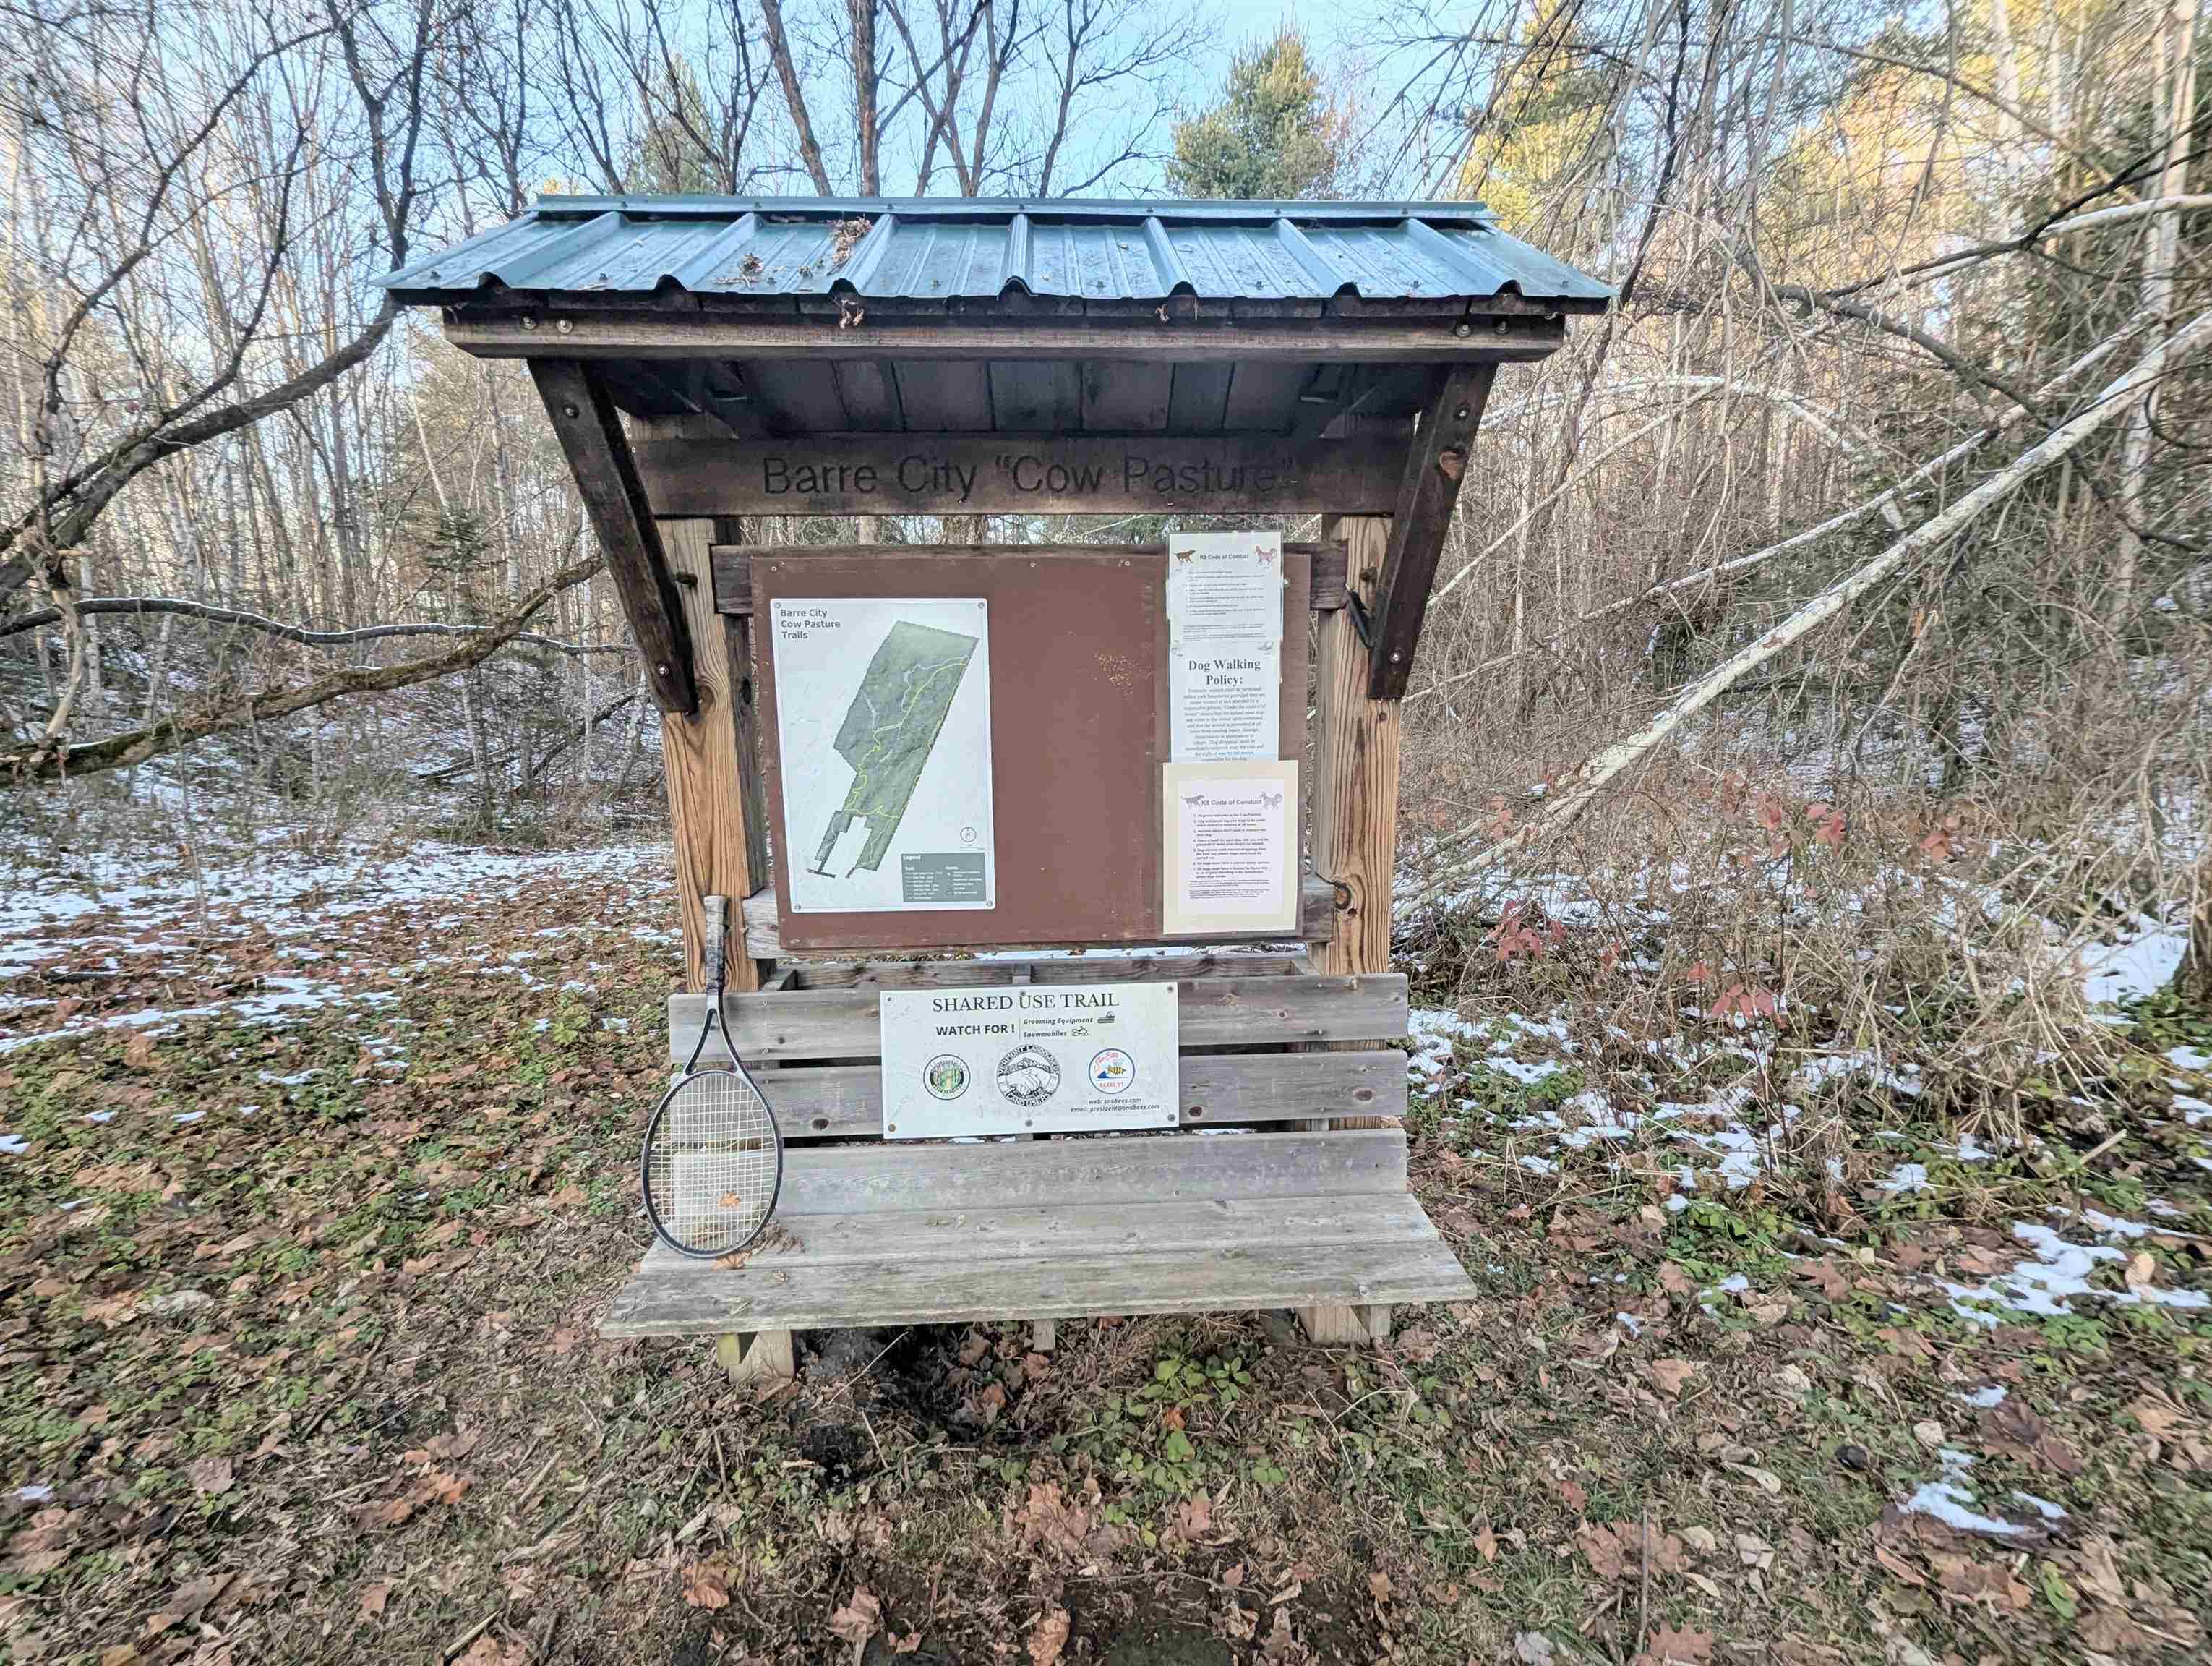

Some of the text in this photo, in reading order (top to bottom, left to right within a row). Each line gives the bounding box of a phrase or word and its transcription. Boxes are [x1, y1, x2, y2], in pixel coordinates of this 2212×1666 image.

[763, 455, 1294, 503] Barre City "Cow Pasture"
[809, 609, 827, 618] City
[1188, 659, 1261, 672] Dog Walking
[1206, 675, 1243, 686] Policy:
[933, 993, 1120, 1012] SHARED USE TRAIL
[936, 1024, 1015, 1035] WATCH FOR !
